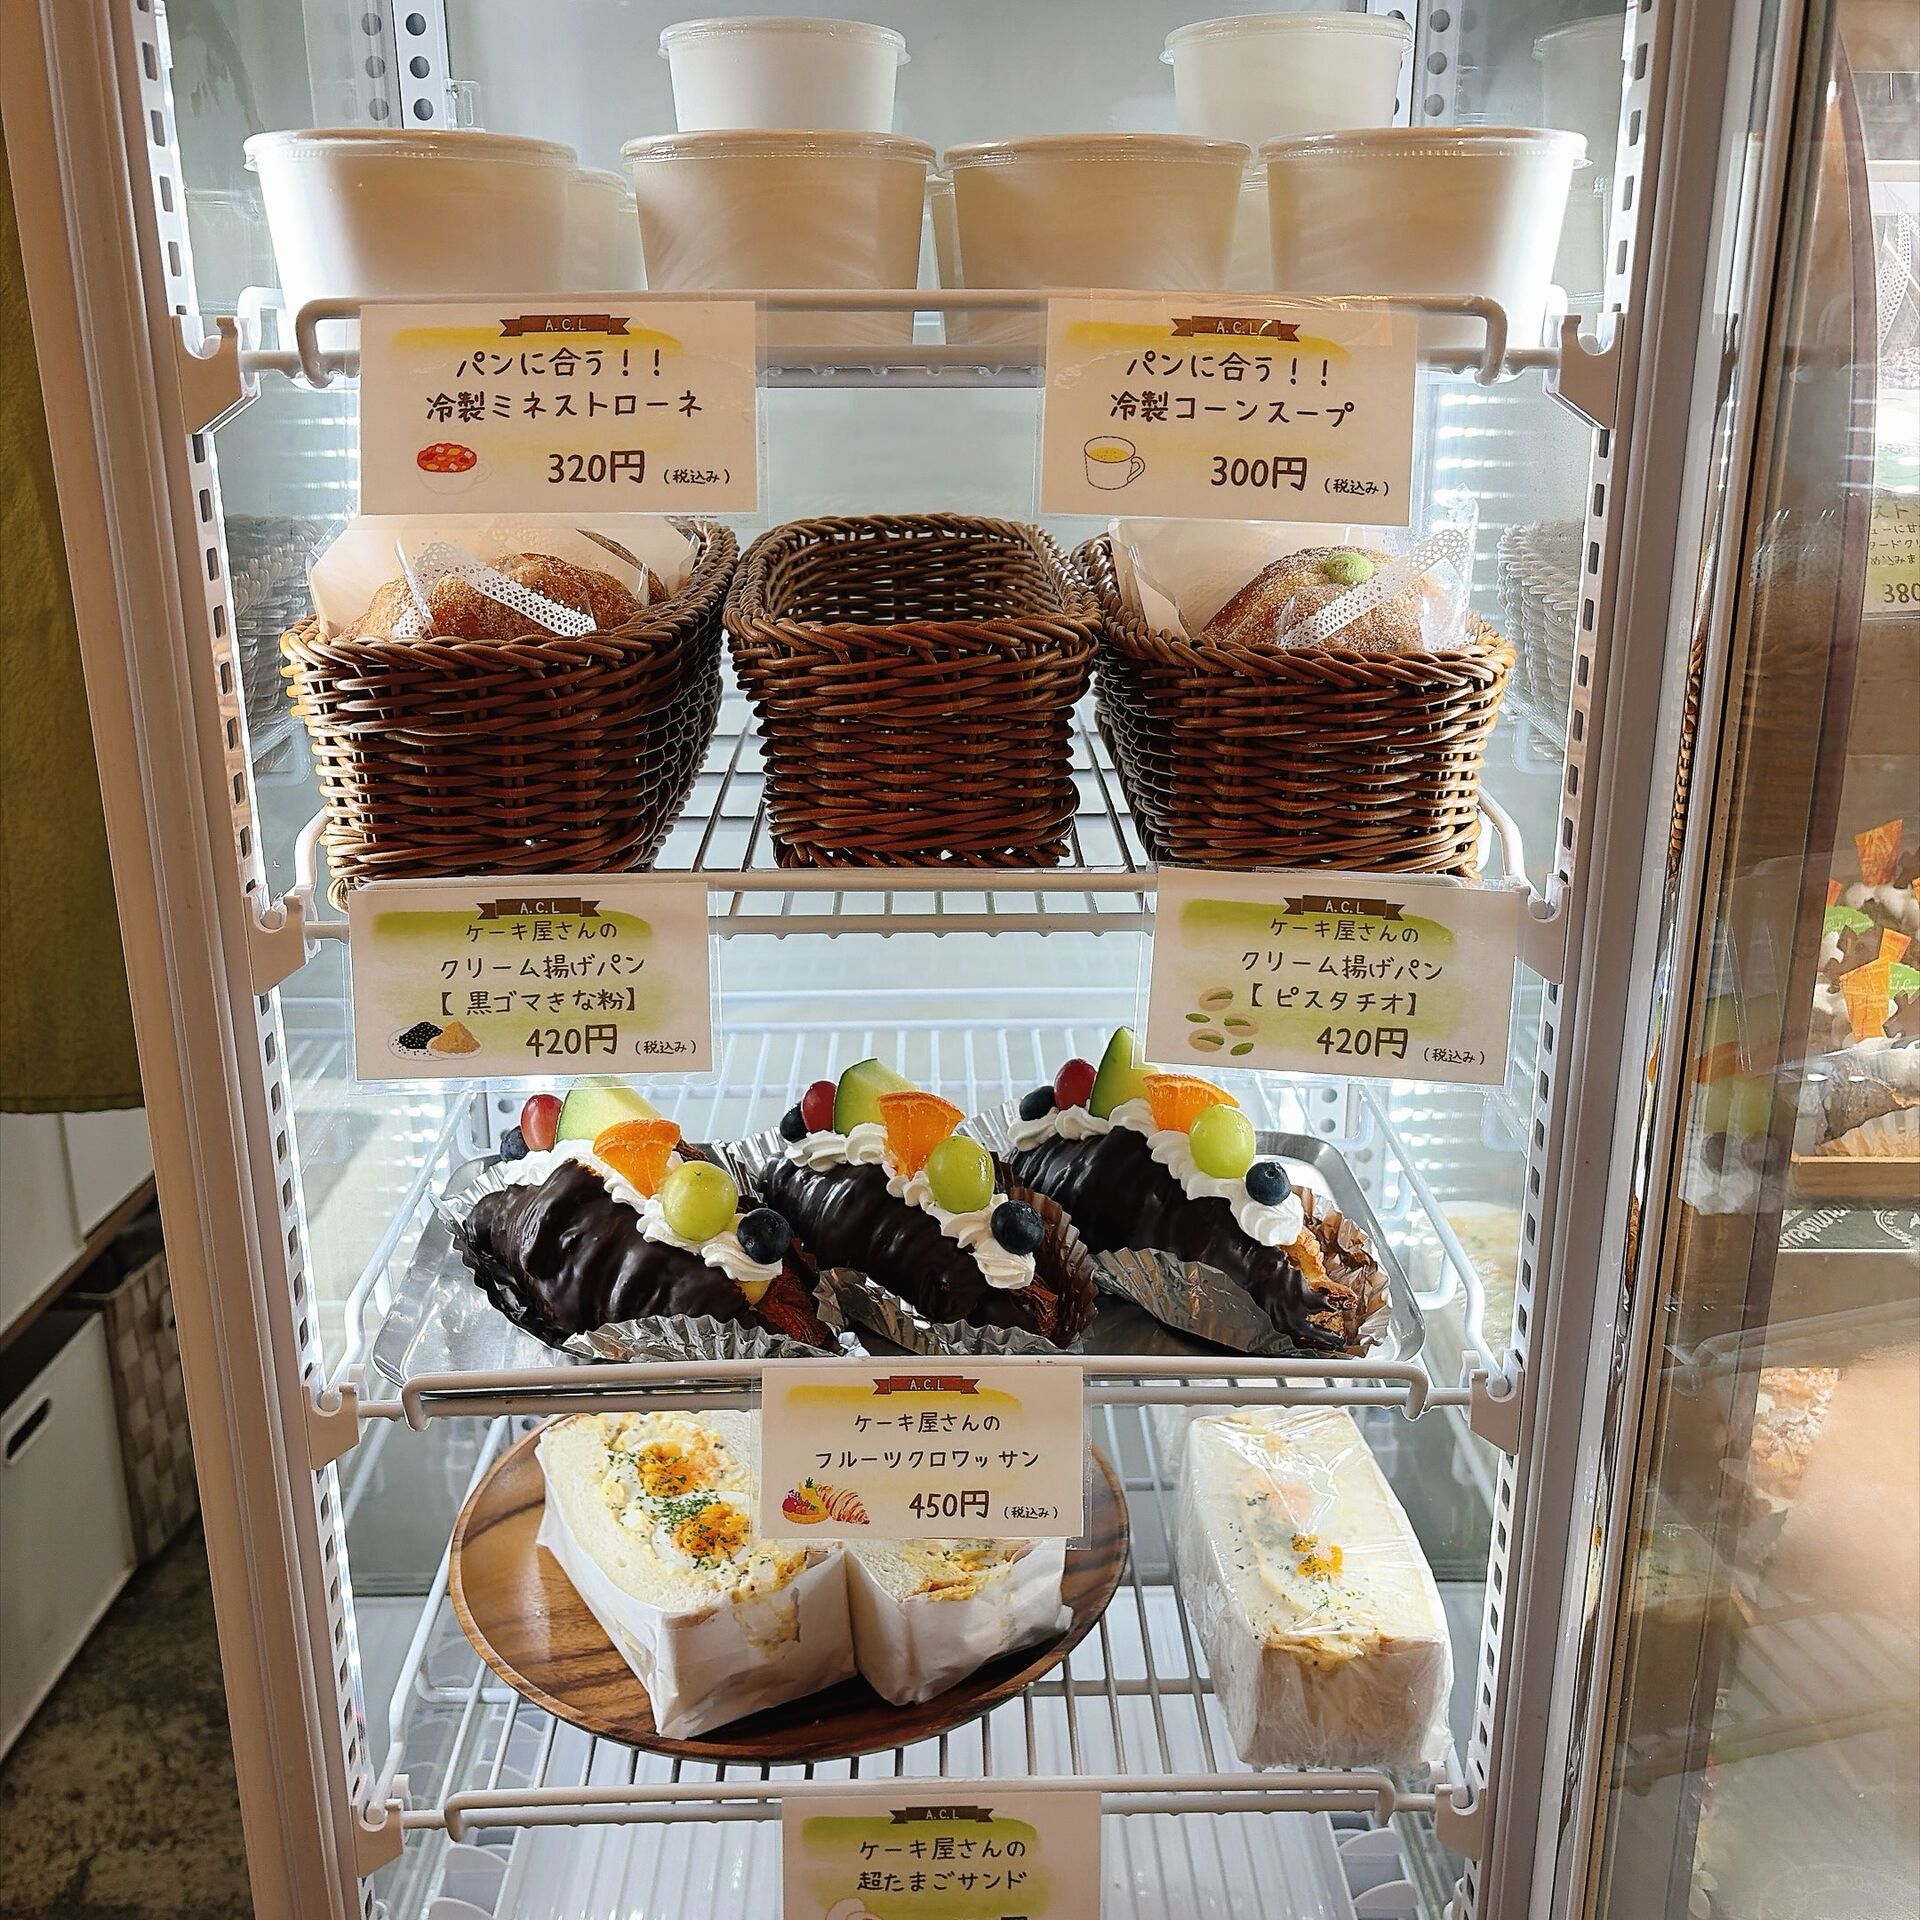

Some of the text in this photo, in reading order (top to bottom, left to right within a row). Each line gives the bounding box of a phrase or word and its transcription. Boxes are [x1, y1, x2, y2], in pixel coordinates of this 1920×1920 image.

[456, 347, 661, 378] パンに合う！！
[1126, 350, 1329, 387] パンに合う！！
[426, 390, 703, 422] 冷製ミネストローネ
[1109, 391, 1354, 428] 冷製コーンスープ
[548, 450, 645, 484] 320円
[1210, 456, 1307, 491] 300円
[465, 919, 617, 942] ケーキ屋さんの
[1270, 917, 1419, 943] ケーキ屋さんの
[440, 953, 645, 979] クリーム揚げパン
[1241, 951, 1443, 981] クリーム揚げパン
[525, 1023, 617, 1057] 420円
[1316, 1026, 1408, 1059] 420円
[854, 1411, 1001, 1433] ケーキ屋さんの
[815, 1450, 1039, 1469] フルーツクロワッサン
[908, 1490, 989, 1519] 450円
[859, 1837, 1026, 1861] ケーキ屋さんの
[857, 1869, 1027, 1892] 超たまごサンド
